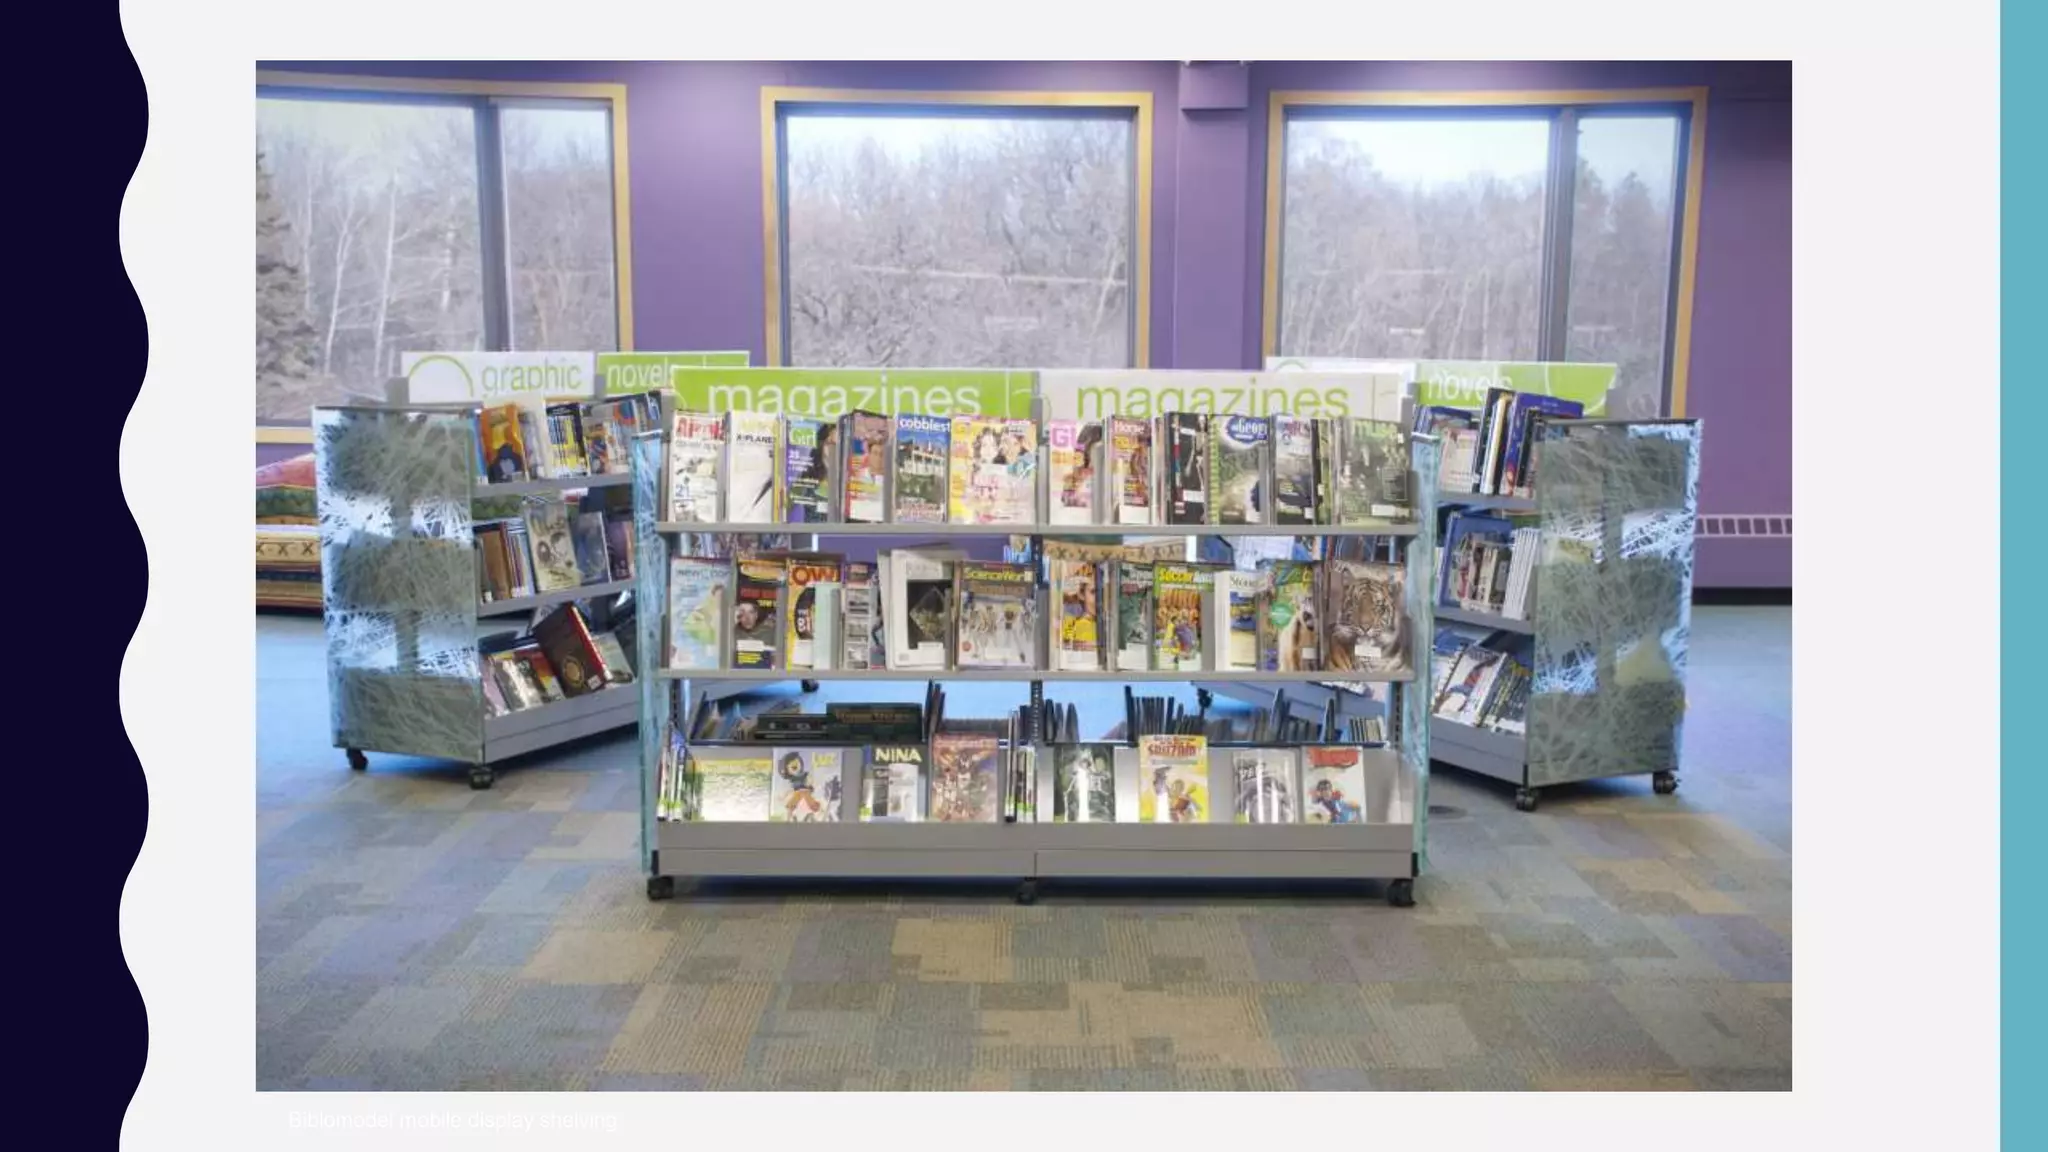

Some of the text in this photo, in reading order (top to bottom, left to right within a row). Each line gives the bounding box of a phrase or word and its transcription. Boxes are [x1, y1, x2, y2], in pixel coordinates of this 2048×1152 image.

[481, 354, 674, 397] graphic novel
[707, 373, 982, 420] magazines
[1076, 377, 1350, 418] magazines
[875, 748, 922, 763] NINA
